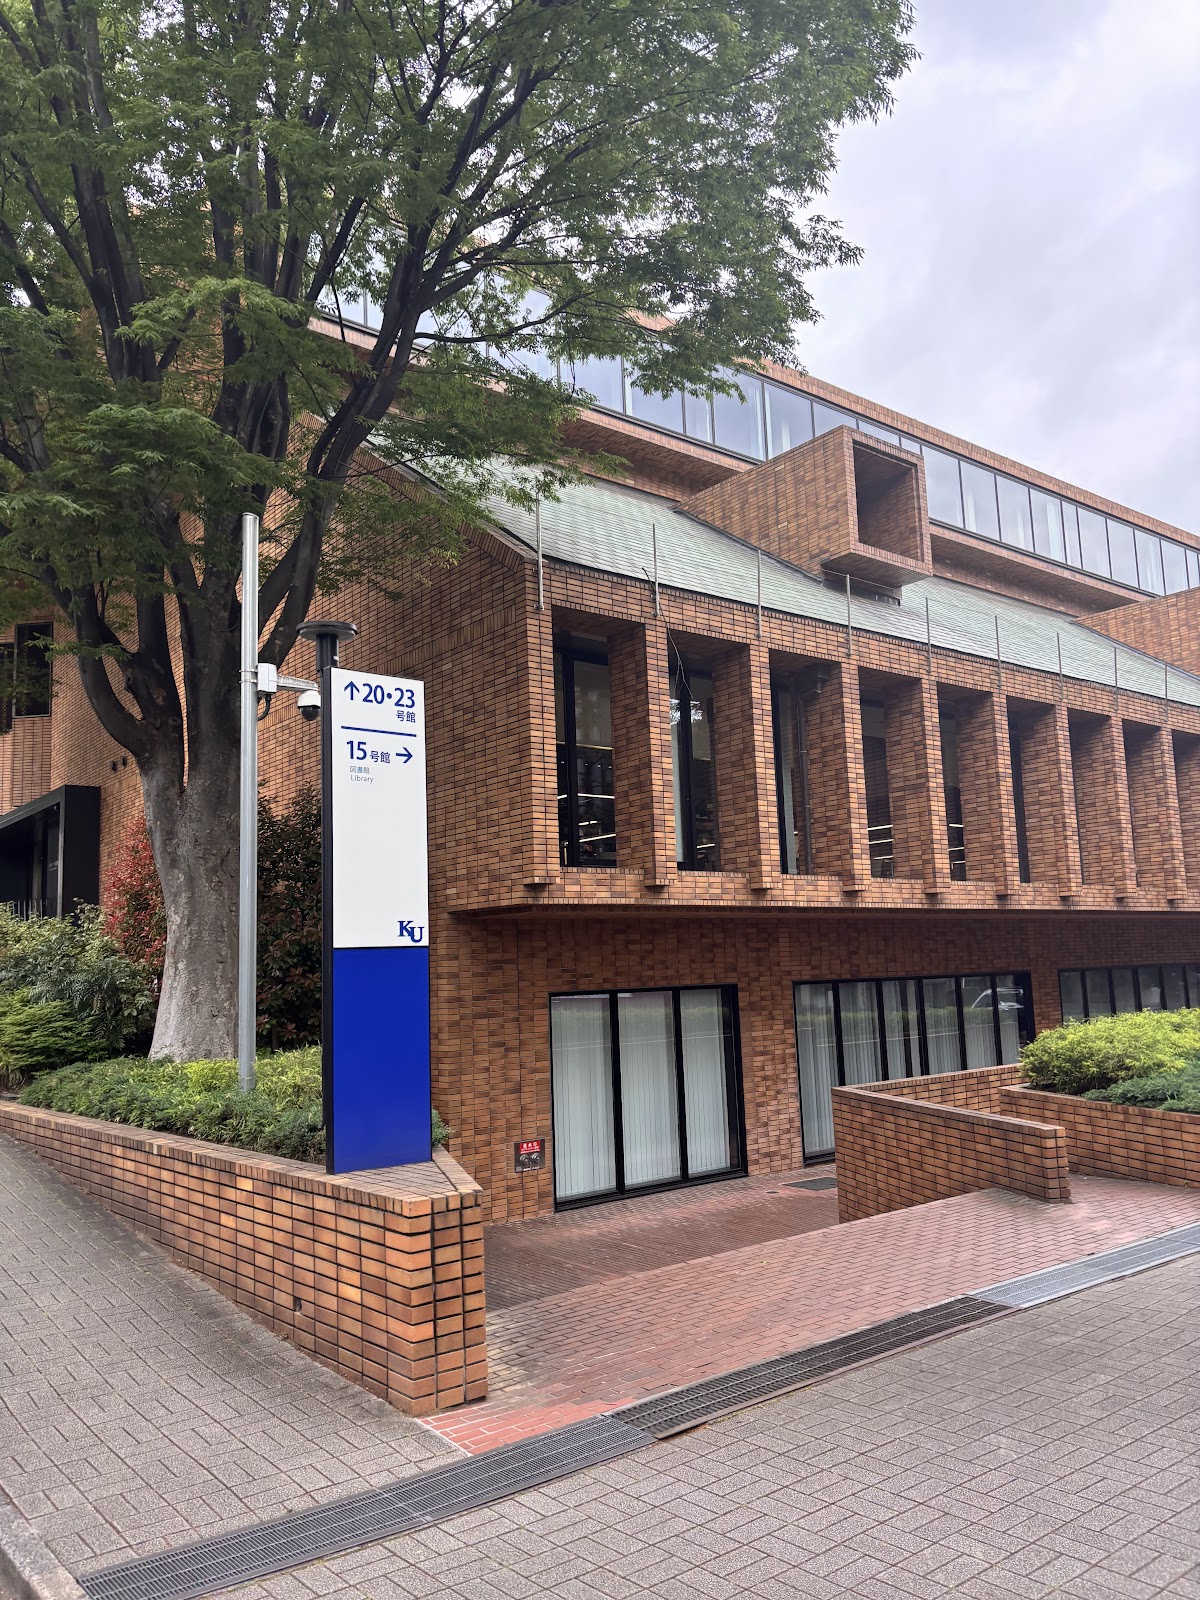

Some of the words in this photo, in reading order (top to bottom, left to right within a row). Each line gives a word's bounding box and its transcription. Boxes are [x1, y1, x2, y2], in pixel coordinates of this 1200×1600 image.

[395, 710, 416, 723] 号館
[349, 766, 370, 774] 図書館
[350, 774, 374, 784] Library
[397, 920, 425, 943] KU
